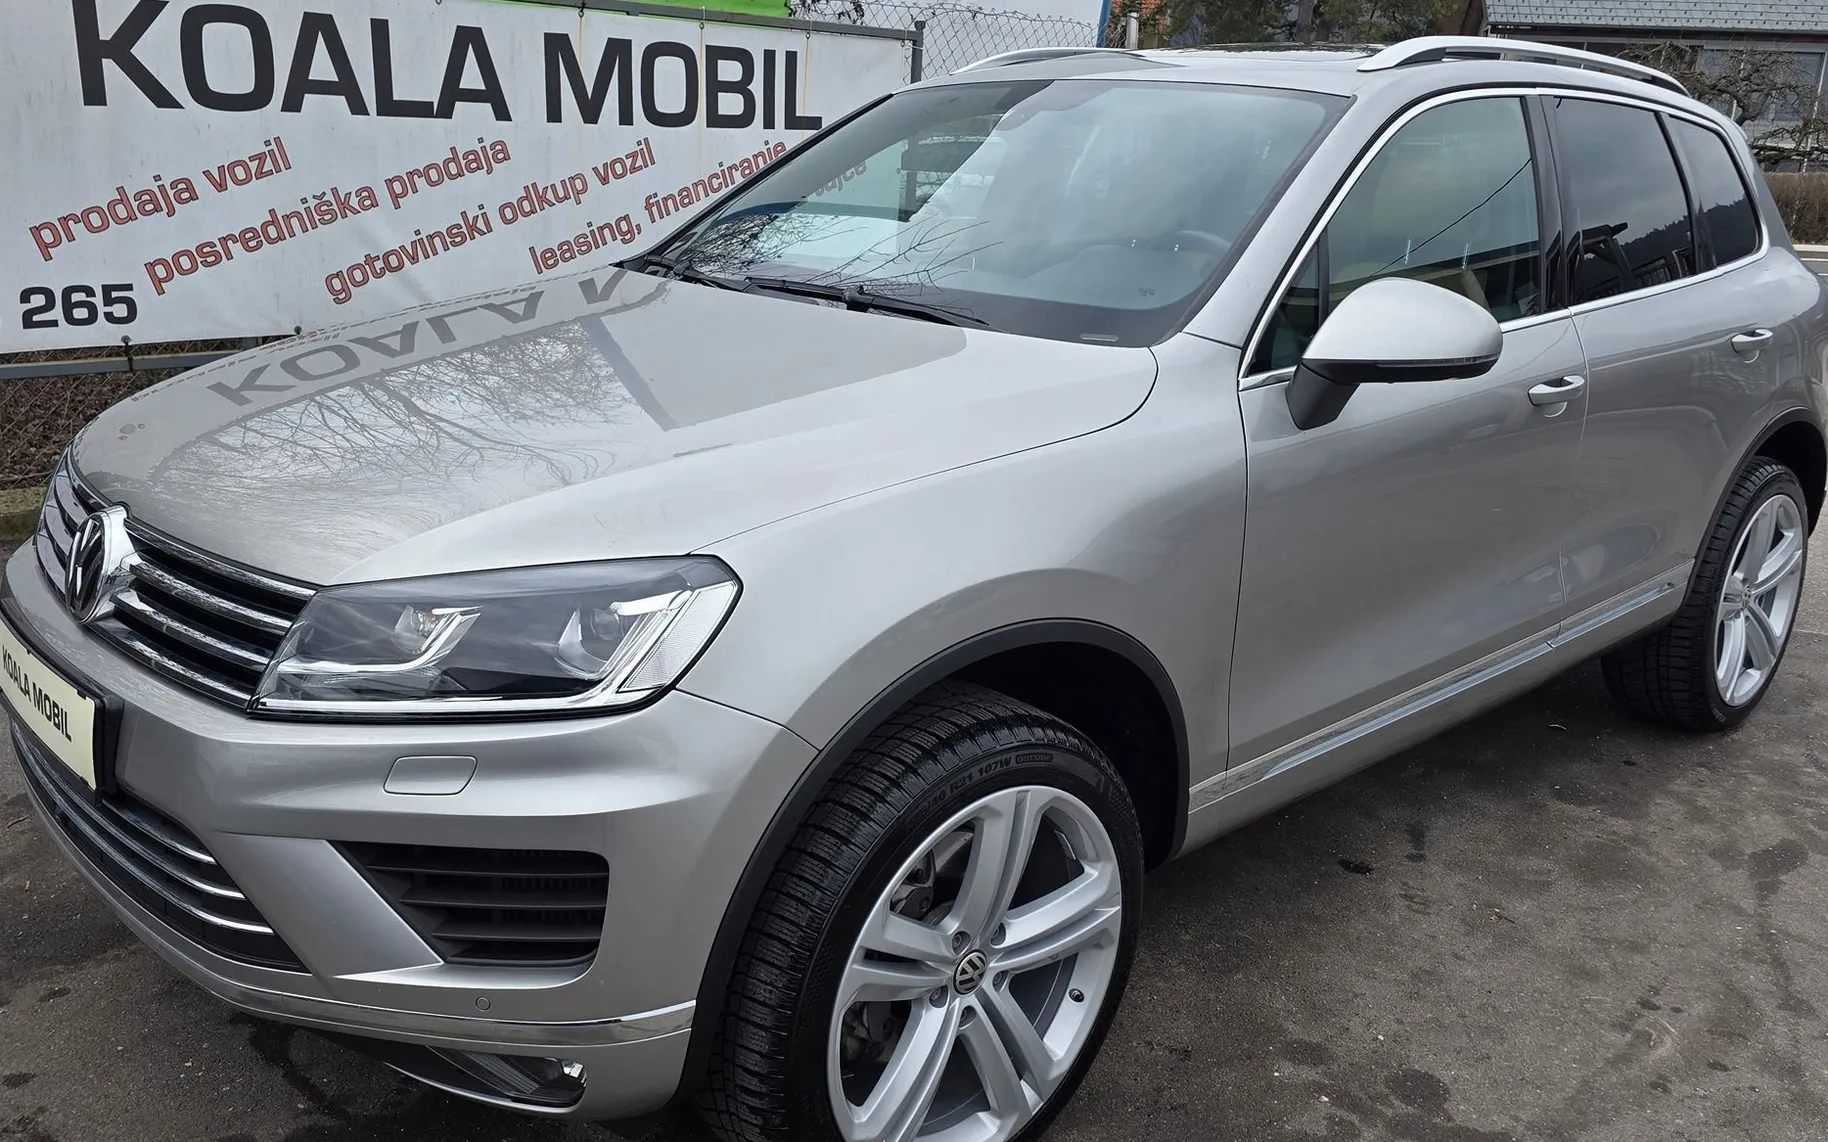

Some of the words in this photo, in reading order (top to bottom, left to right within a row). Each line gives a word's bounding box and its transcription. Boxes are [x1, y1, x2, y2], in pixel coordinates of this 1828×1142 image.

[73, 0, 512, 122] KOALA
[543, 32, 823, 131] MOBIL
[29, 174, 199, 262] prodaja
[202, 136, 292, 194] vozil
[144, 186, 379, 296] posredniška
[384, 136, 512, 211] prodaja
[324, 203, 493, 305] gotovinski
[498, 171, 589, 226] odkup
[592, 137, 656, 187] vozil
[529, 212, 643, 275] leasing,
[19, 283, 138, 330] 265
[2, 644, 32, 702] KOALA
[32, 681, 73, 742] MOBIL
[977, 756, 1013, 778] 107W
